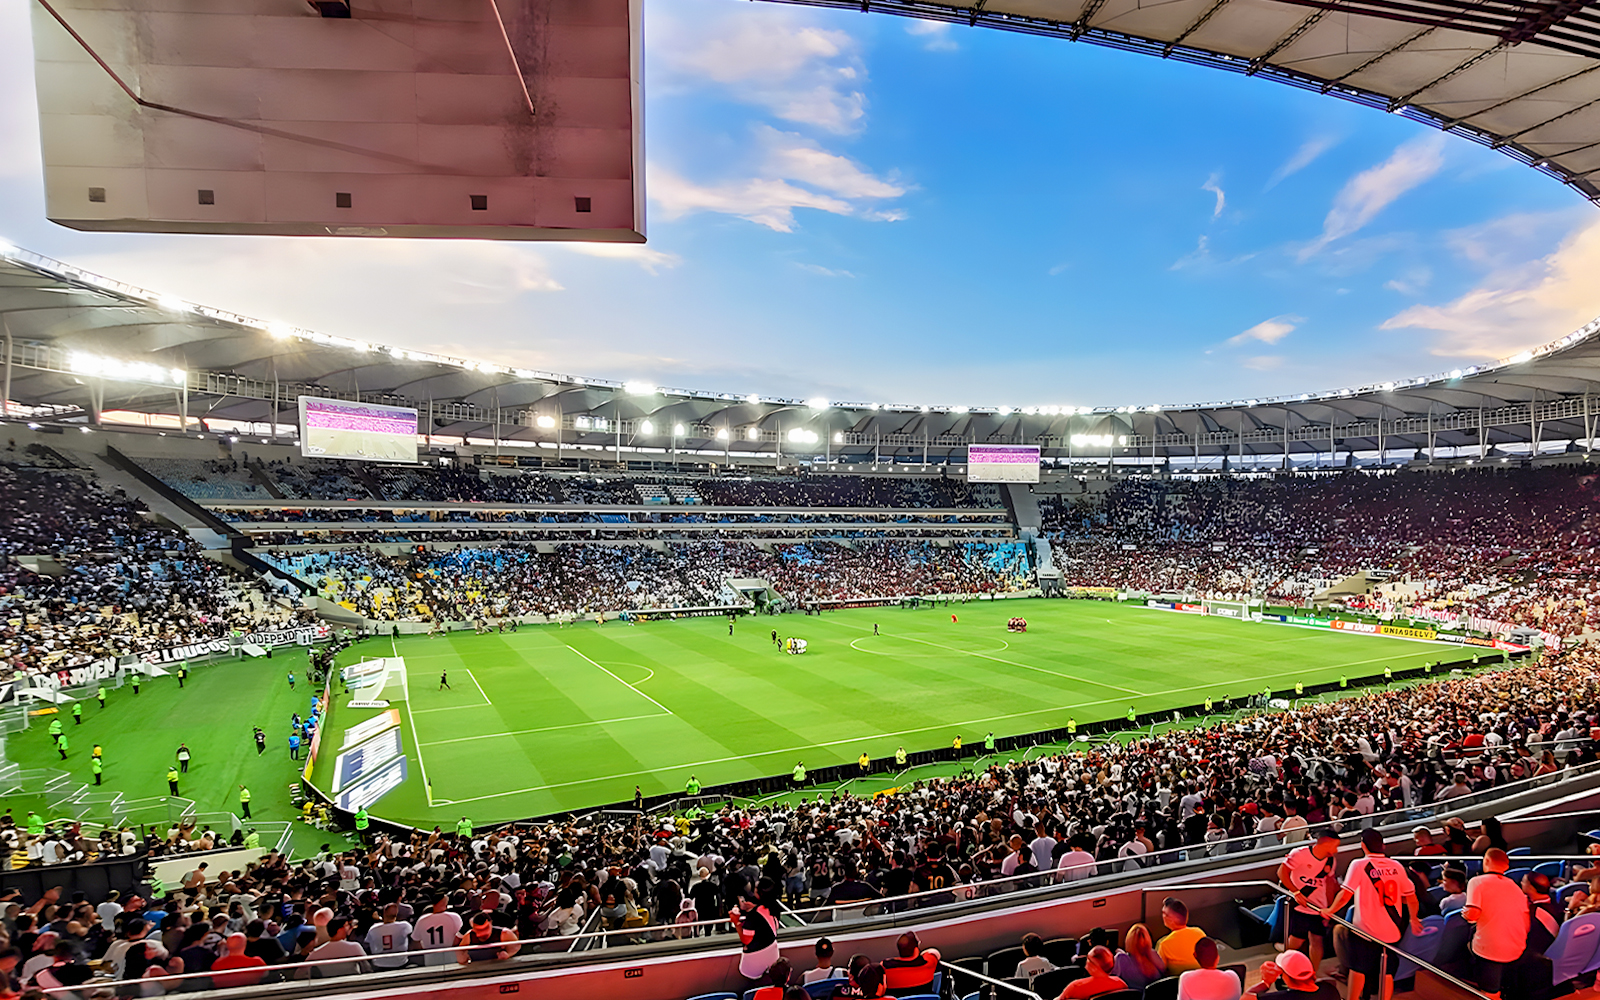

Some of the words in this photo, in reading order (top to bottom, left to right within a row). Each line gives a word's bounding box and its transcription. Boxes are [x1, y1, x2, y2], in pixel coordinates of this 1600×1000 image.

[162, 640, 230, 662] LOUCOS
[927, 875, 944, 890] 10
[382, 935, 393, 950] 9
[426, 926, 444, 945] 11
